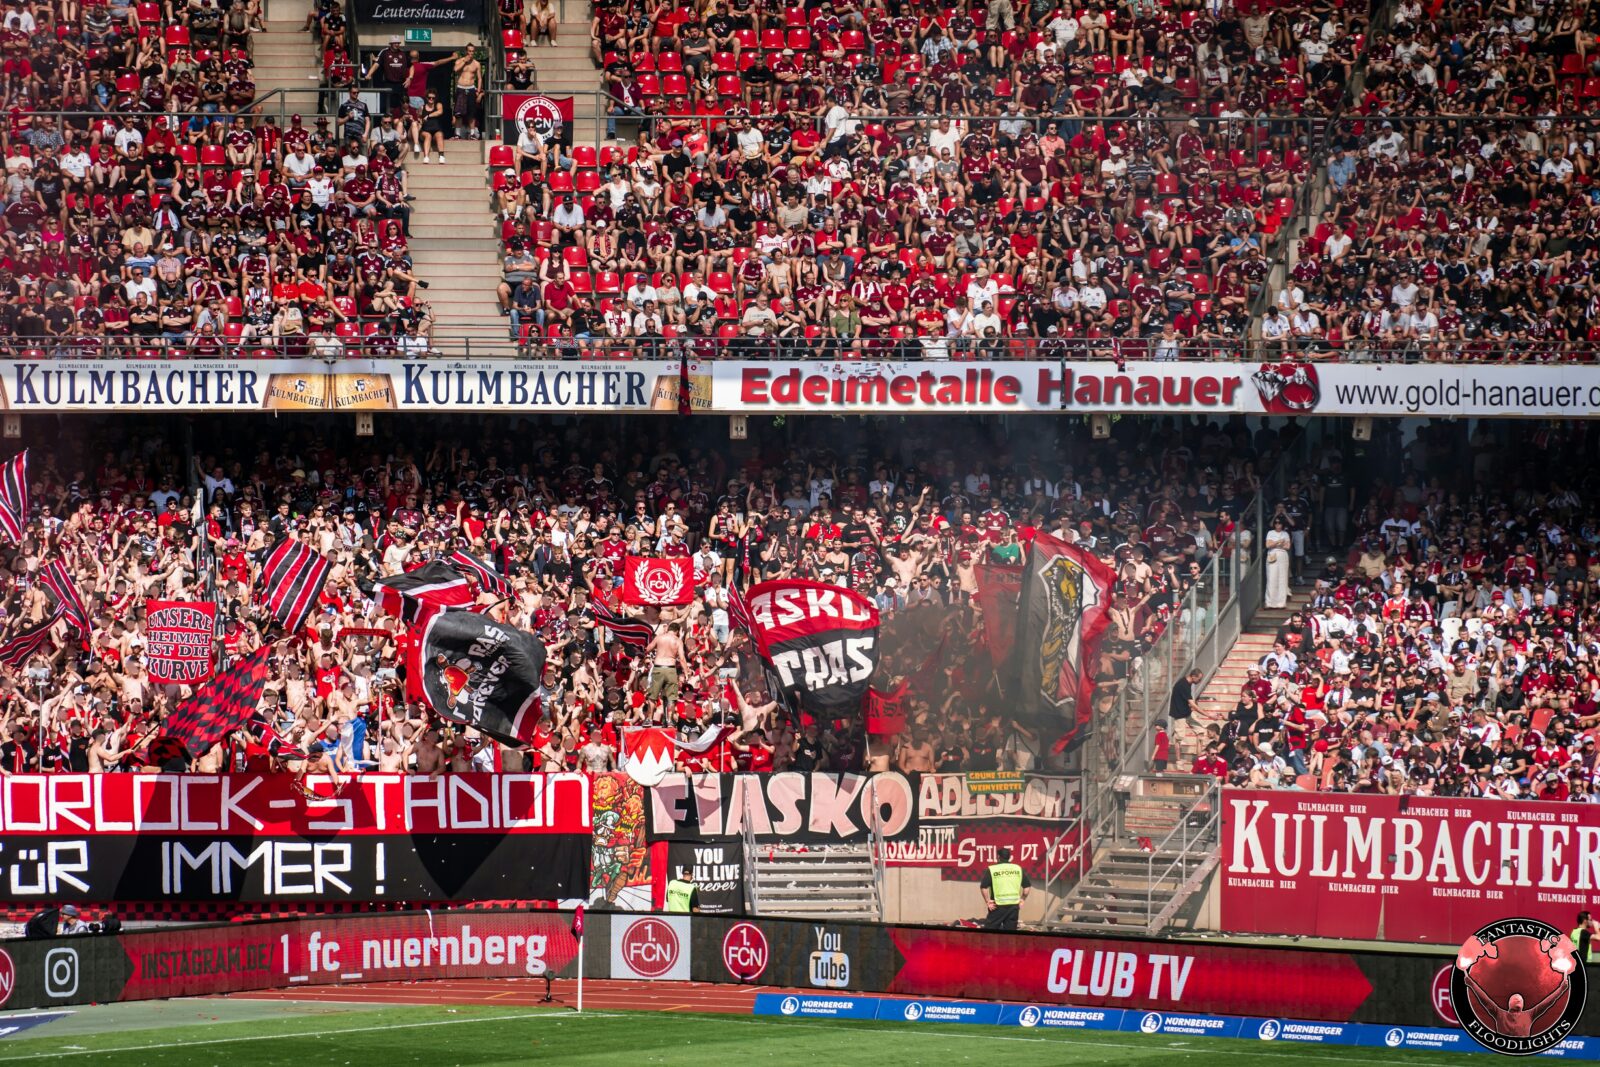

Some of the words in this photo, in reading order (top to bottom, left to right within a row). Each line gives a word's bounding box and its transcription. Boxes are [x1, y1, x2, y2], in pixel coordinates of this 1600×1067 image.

[372, 4, 465, 19] Leutershausen
[14, 363, 259, 405] KULMBACHER
[402, 363, 647, 406] KULMBACHER
[741, 367, 1021, 404] Edelmetalle
[1038, 367, 1242, 404] Hanauer
[270, 386, 326, 407] KULMBACHER
[650, 580, 670, 589] FCN
[147, 607, 213, 632] UNSERE
[148, 631, 211, 645] HEIMAT
[147, 643, 174, 656] IST
[178, 644, 209, 657] DIE
[147, 657, 209, 681] KURVE
[0, 773, 591, 831] ORLOCK-STADION
[650, 771, 913, 837] FIASKO
[1297, 801, 1344, 813] KULMBACHER
[1350, 804, 1367, 814] BIER
[1454, 809, 1472, 818] BIER
[1507, 810, 1556, 822] KULMBACHER
[1561, 813, 1579, 823] BIER
[1228, 799, 1600, 891] KULMBACHER
[693, 848, 723, 865] YOU
[1020, 844, 1038, 861] DI
[0, 841, 91, 895] ÜR
[162, 841, 352, 895] IMMER
[712, 864, 740, 881] LIVE
[1228, 877, 1274, 889] KULMBACHER
[1280, 880, 1296, 889] BIER
[1328, 882, 1375, 894] KULMBACHER
[1381, 885, 1399, 895] BIER
[1432, 887, 1481, 898] KULMBACHER
[1486, 890, 1504, 900] BIER
[1537, 892, 1587, 904] KULMBACHER
[815, 926, 841, 952] You
[629, 942, 671, 963] FCN
[728, 946, 763, 967] FCN
[812, 955, 847, 981] Tube
[1047, 948, 1138, 998] CLUB
[1148, 953, 1195, 1001] TV
[801, 999, 854, 1010] NÜRNBERGER
[925, 1005, 976, 1016] NÜRNBERGER
[924, 1012, 960, 1020] VERSICHERUNG
[1044, 1009, 1105, 1021] NÜRNBERGER
[1164, 1015, 1225, 1029] NÜRNBERGER
[1042, 1019, 1085, 1027] VERSICHERUNG
[1163, 1025, 1205, 1034] VERSICHERUNG
[1282, 1023, 1343, 1037] NÜRNBERGER
[1281, 1033, 1324, 1041] VERSICHERUNG
[1405, 1039, 1443, 1048] VERSICHERUNG
[1406, 1031, 1460, 1043] NÜRNBERGER
